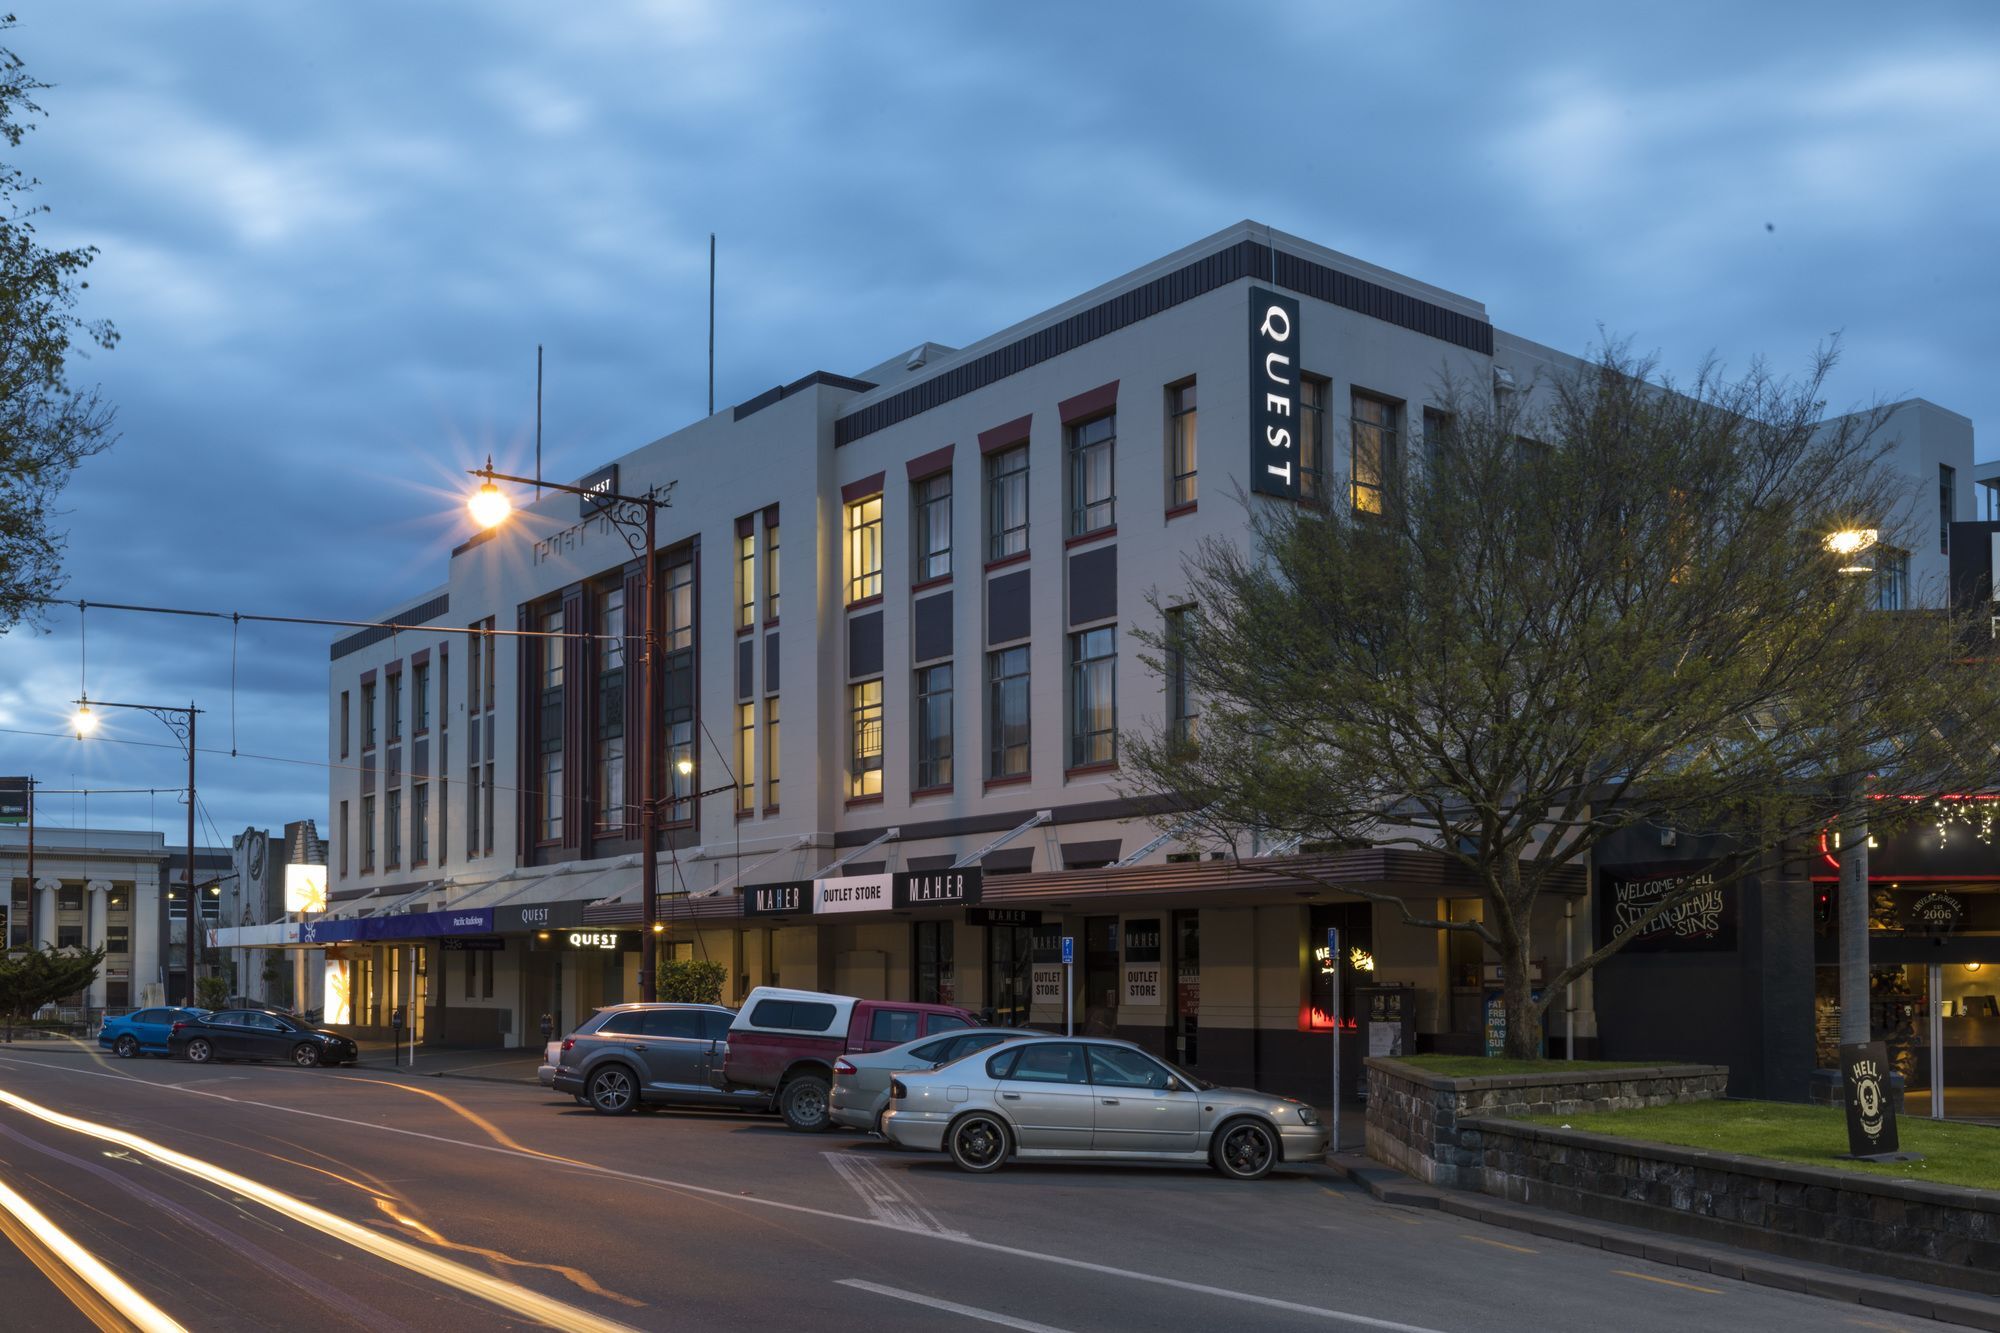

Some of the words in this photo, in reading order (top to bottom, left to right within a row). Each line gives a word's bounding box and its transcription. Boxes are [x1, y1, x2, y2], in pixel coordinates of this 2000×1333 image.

[1260, 305, 1291, 486] QUEST
[823, 887, 853, 902] OUTLET
[855, 885, 881, 900] STORE
[909, 874, 963, 902] MAHER
[1614, 878, 1676, 902] WELCOME
[757, 887, 800, 912] MAHER
[521, 908, 549, 924] QUEST
[988, 910, 1026, 921] MAHER
[1923, 909, 1952, 920] 2006
[1675, 912, 1719, 937] SINS
[569, 933, 618, 947] QUEST
[1126, 932, 1159, 948] MAHER
[1034, 972, 1061, 983] OUTLET
[1127, 971, 1158, 983] OUTLET
[1036, 985, 1060, 996] STORE
[1130, 985, 1156, 997] STORE
[1852, 1060, 1878, 1080] HELL
